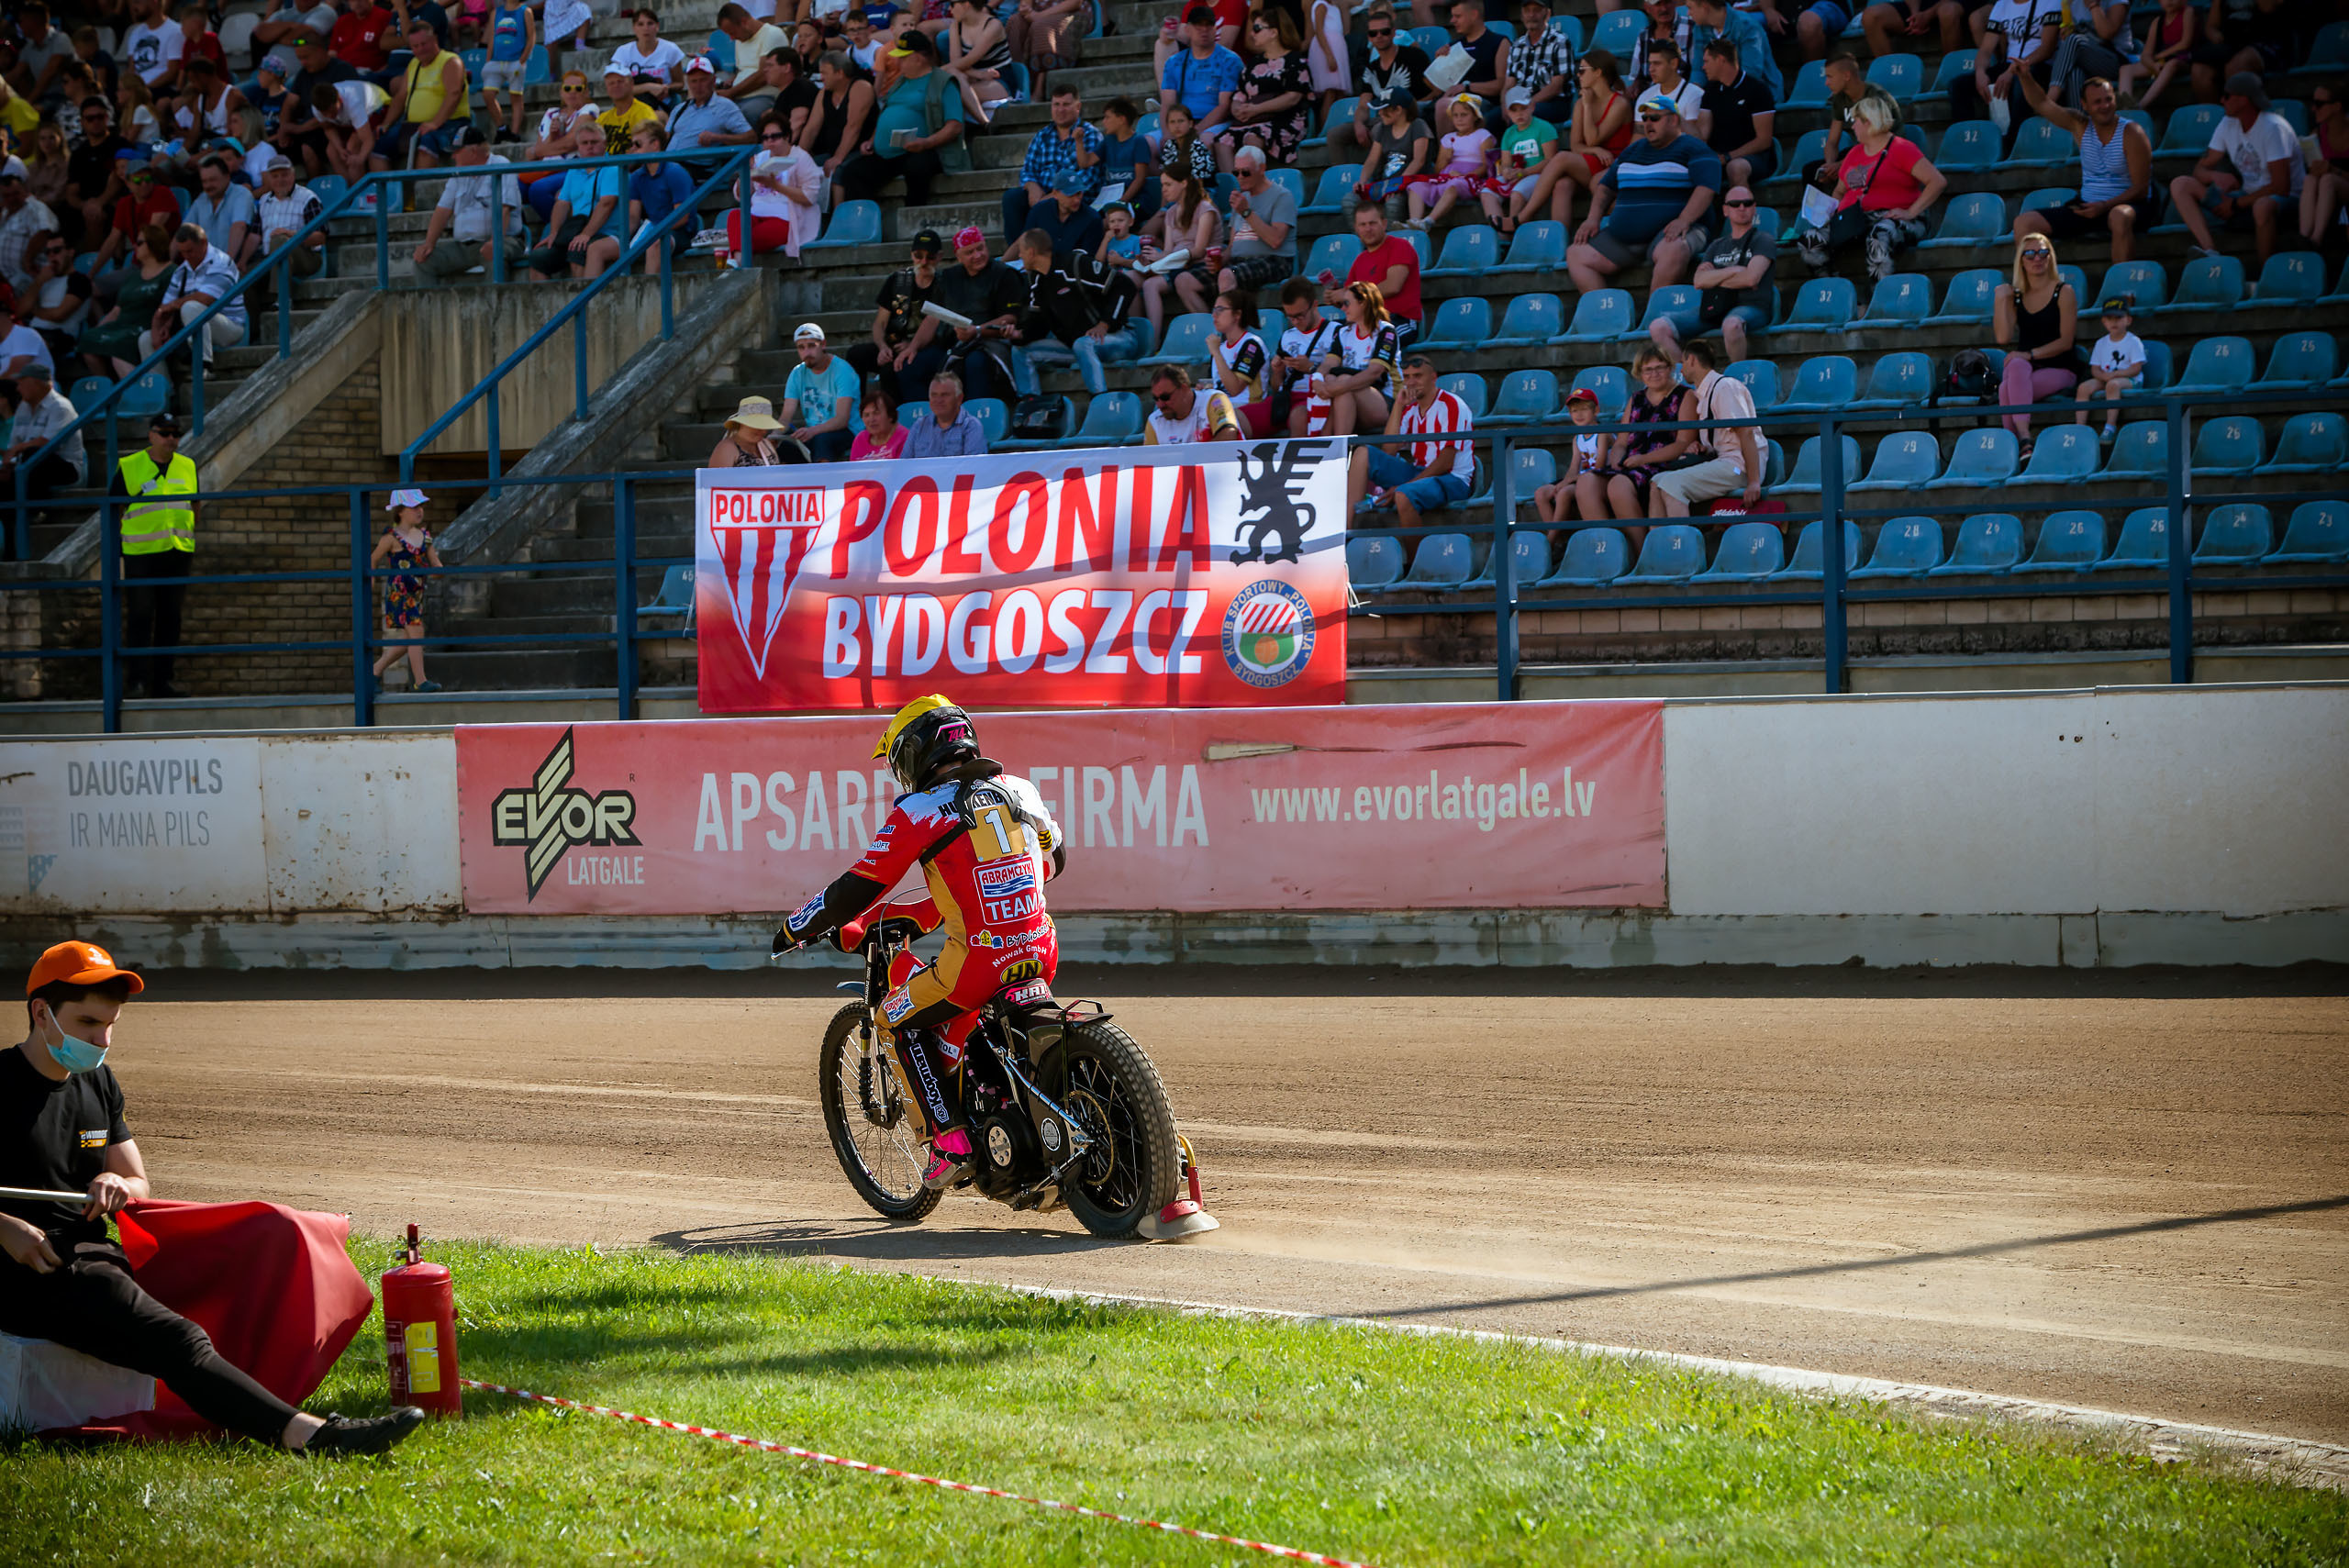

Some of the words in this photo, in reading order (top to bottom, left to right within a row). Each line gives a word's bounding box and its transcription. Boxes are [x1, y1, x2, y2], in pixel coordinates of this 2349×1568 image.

[1461, 303, 1472, 315] 37
[1600, 297, 1614, 309] 35
[1674, 294, 1686, 305] 34
[1820, 290, 1831, 302] 32
[1903, 440, 1916, 453] 29
[714, 491, 820, 525] POLONIA
[829, 463, 1211, 580] POLONIA
[2070, 522, 2083, 534] 26
[682, 570, 695, 582] 45
[823, 587, 1209, 680] BYDGOSZCZ
[1223, 620, 1235, 658] KLUB
[1229, 580, 1286, 618] SPORTOWY
[1233, 662, 1300, 687] BYDGOSZCZ
[68, 759, 224, 796] DAUGAVPILS
[694, 769, 907, 852] APSARD
[1029, 764, 1209, 849] FIRMA
[1251, 766, 1597, 832] www.evorlatgale.lv
[71, 812, 90, 849] IR
[97, 811, 159, 848] MANA
[165, 810, 211, 847] PILS
[984, 808, 1012, 855] 1
[567, 856, 645, 885] LATGALE
[981, 864, 1033, 885] ABRAMCZYK
[986, 893, 1038, 922] TEAM
[992, 948, 1024, 968] Nowak
[1026, 945, 1047, 955] GmbH
